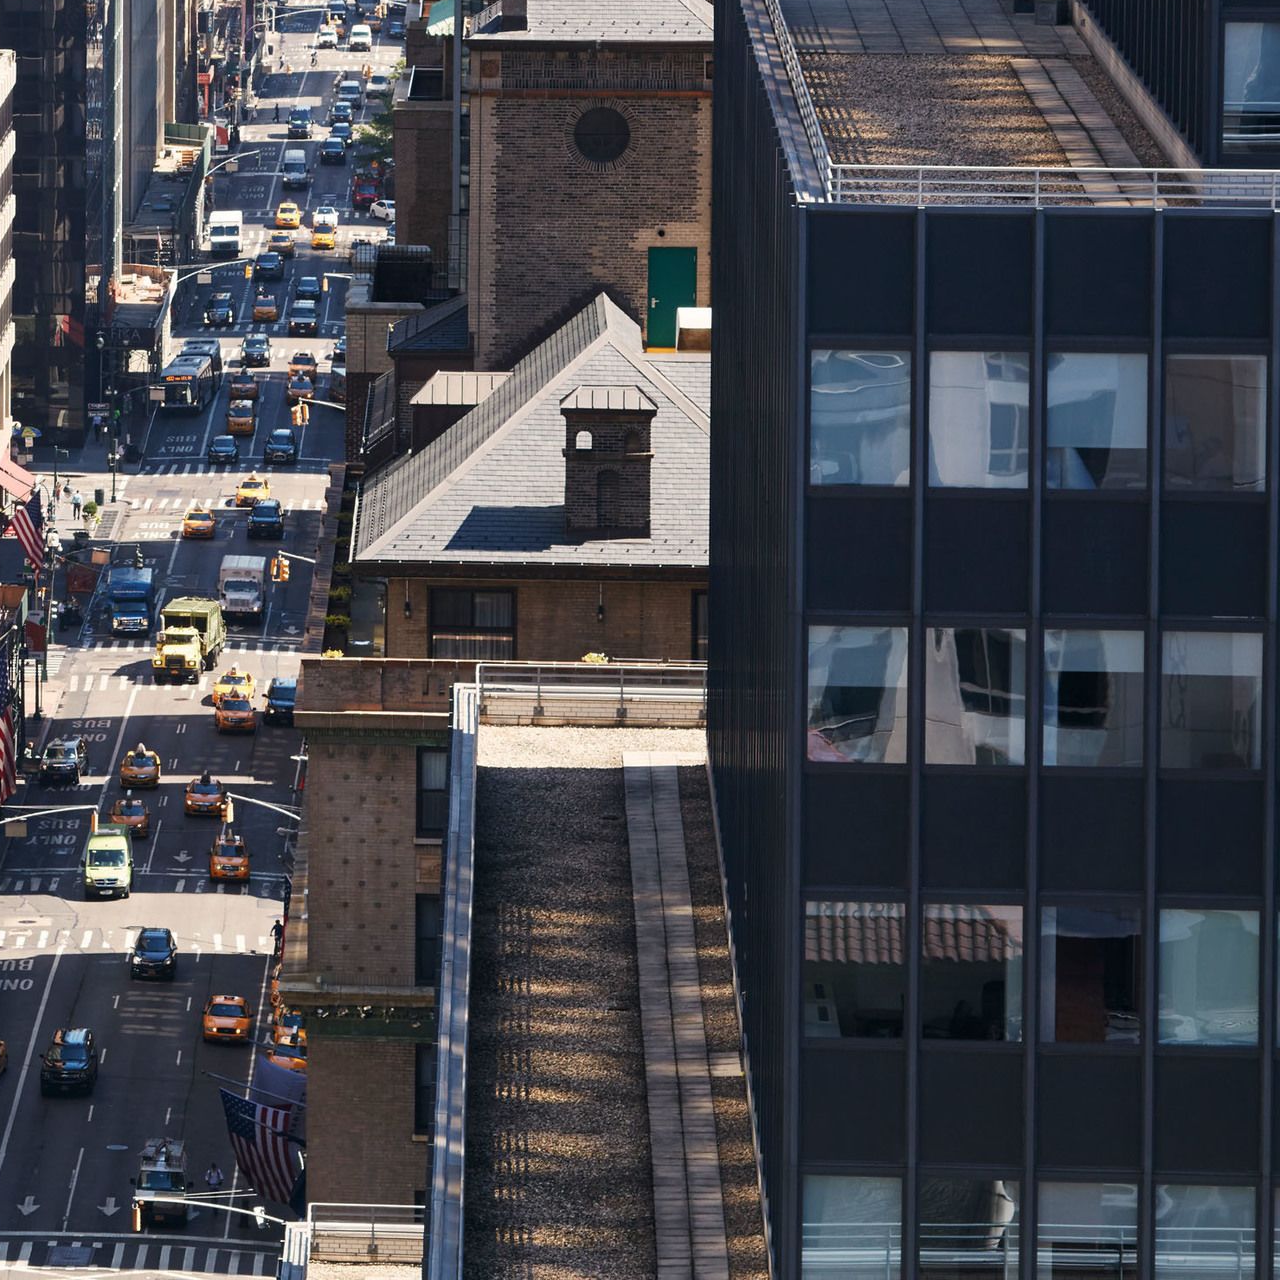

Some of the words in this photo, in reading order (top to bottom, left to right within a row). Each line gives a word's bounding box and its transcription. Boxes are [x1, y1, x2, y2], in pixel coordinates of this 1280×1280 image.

[133, 531, 171, 539] ONLY
[72, 719, 111, 728] BUS
[38, 819, 80, 829] BUS
[25, 834, 77, 845] ONLY
